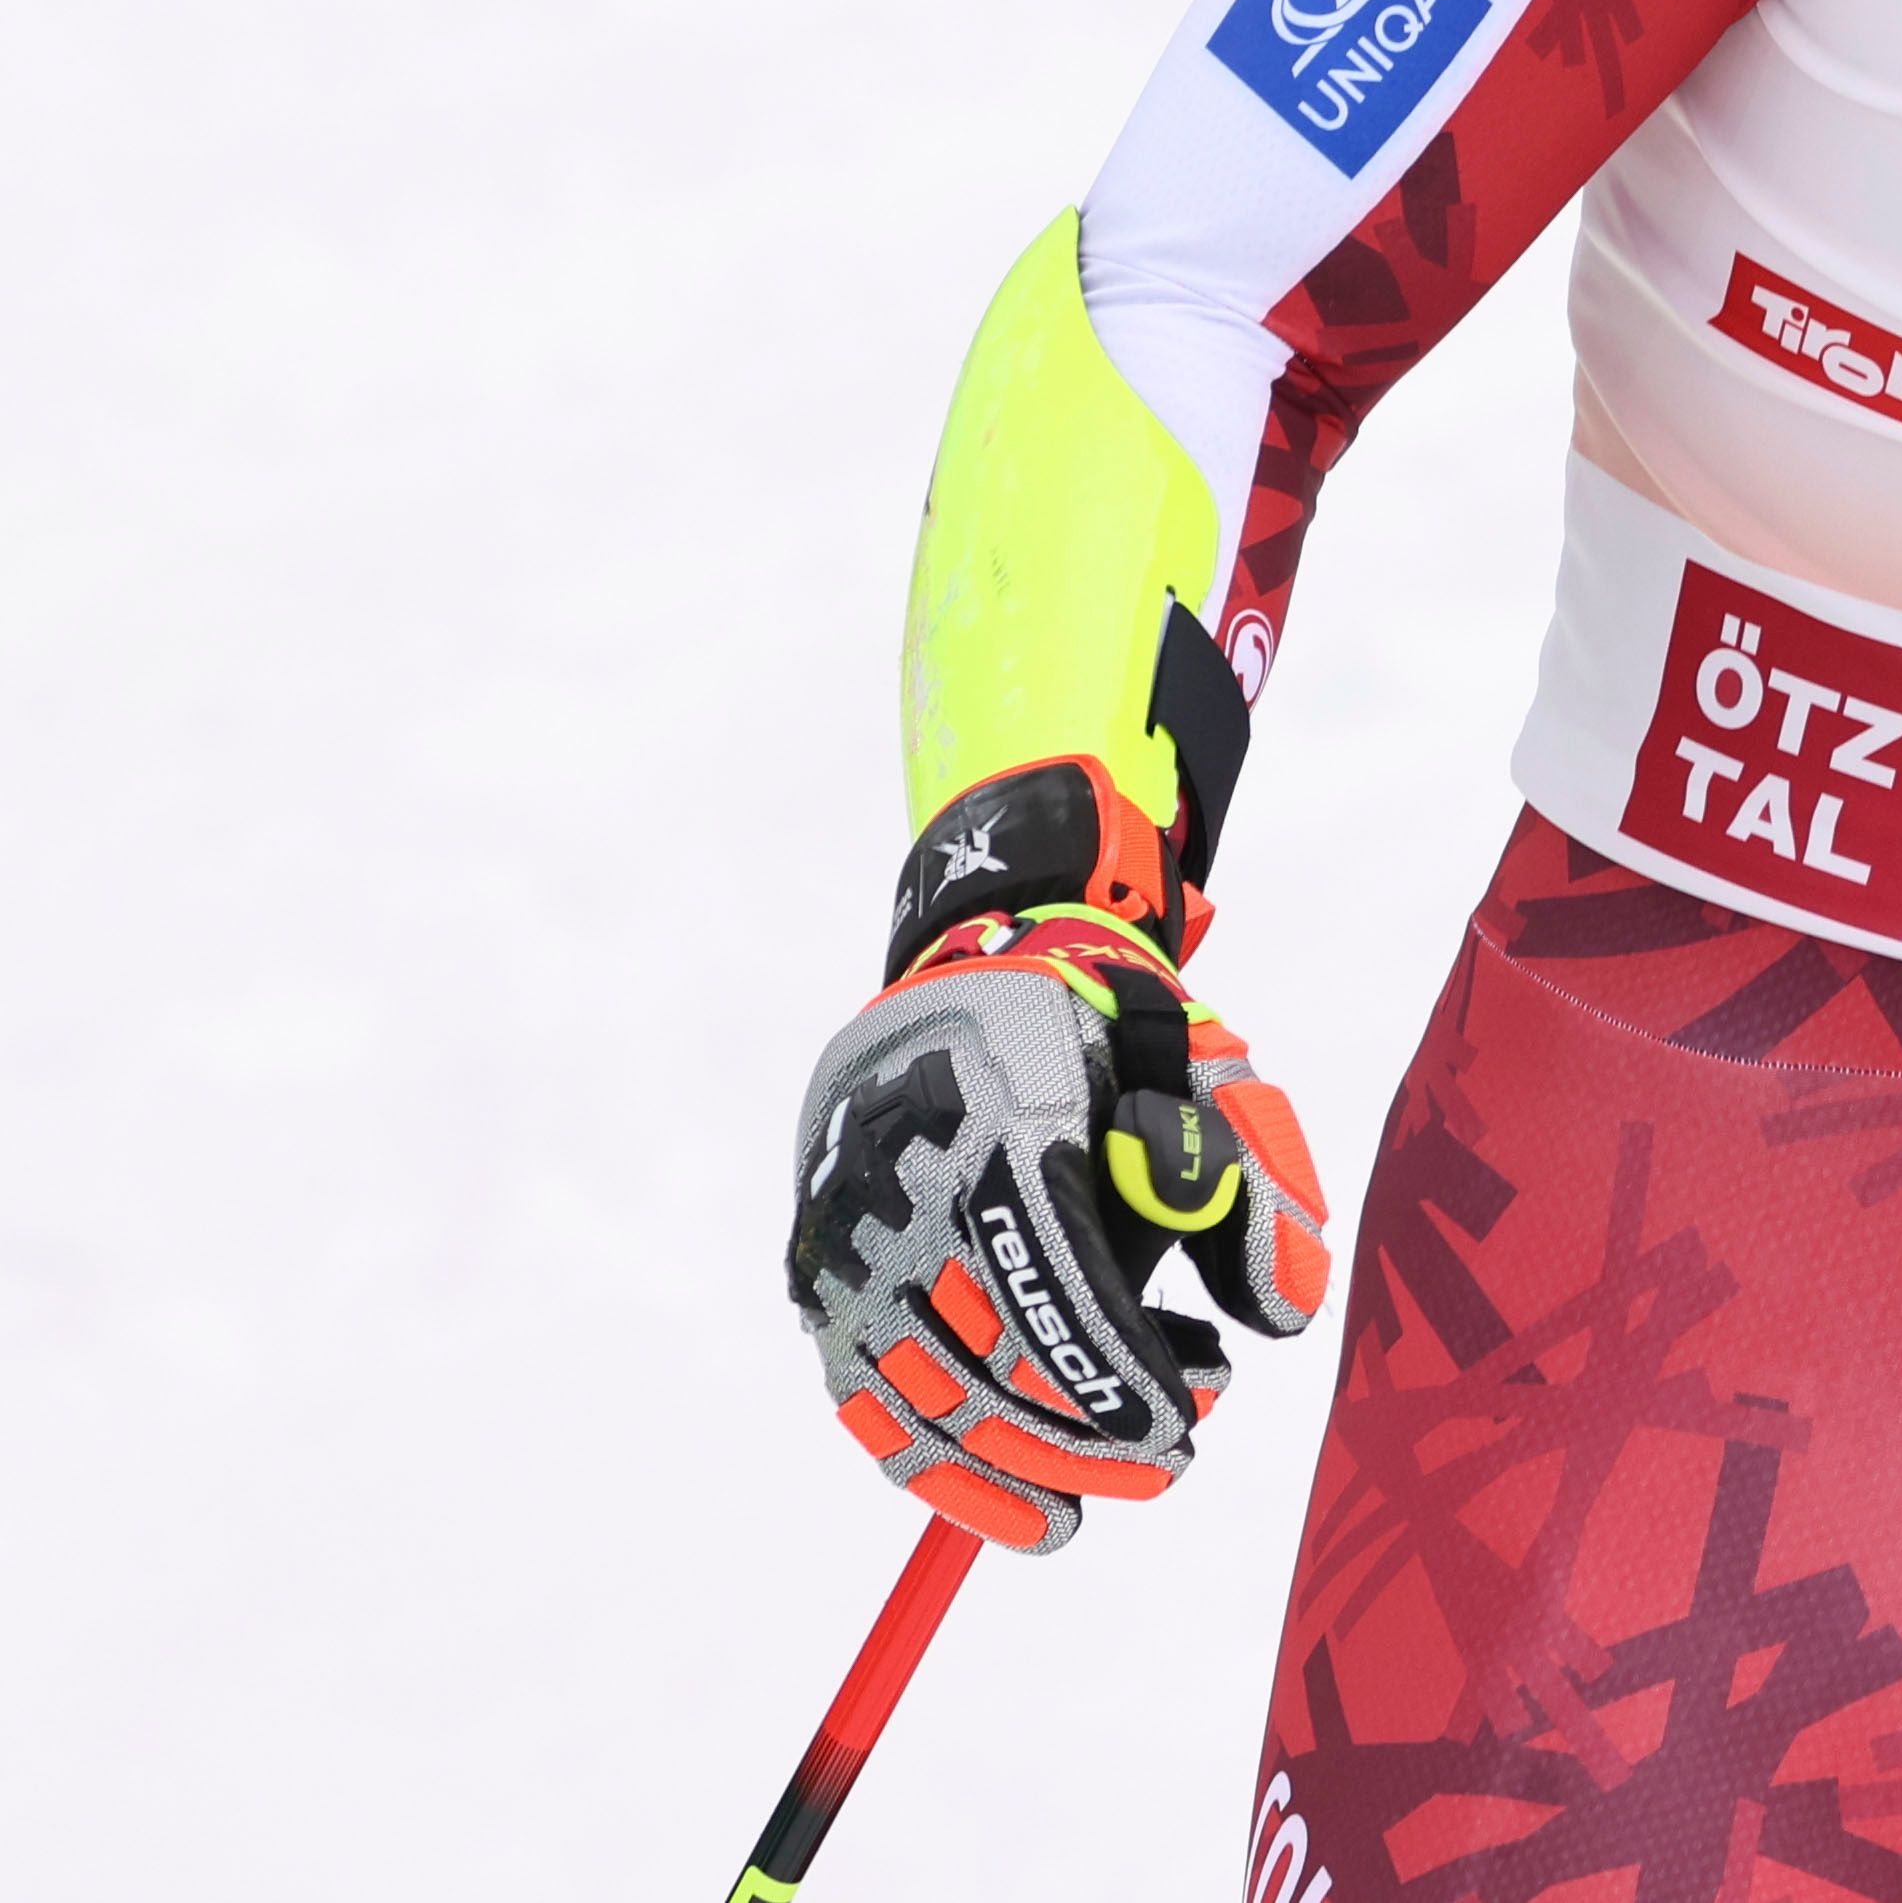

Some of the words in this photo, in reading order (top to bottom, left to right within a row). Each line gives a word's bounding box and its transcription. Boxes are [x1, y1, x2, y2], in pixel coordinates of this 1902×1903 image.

[1674, 734, 1873, 887] TAL
[1178, 1104, 1200, 1183] LEKI
[980, 1205, 1123, 1414] reusch
